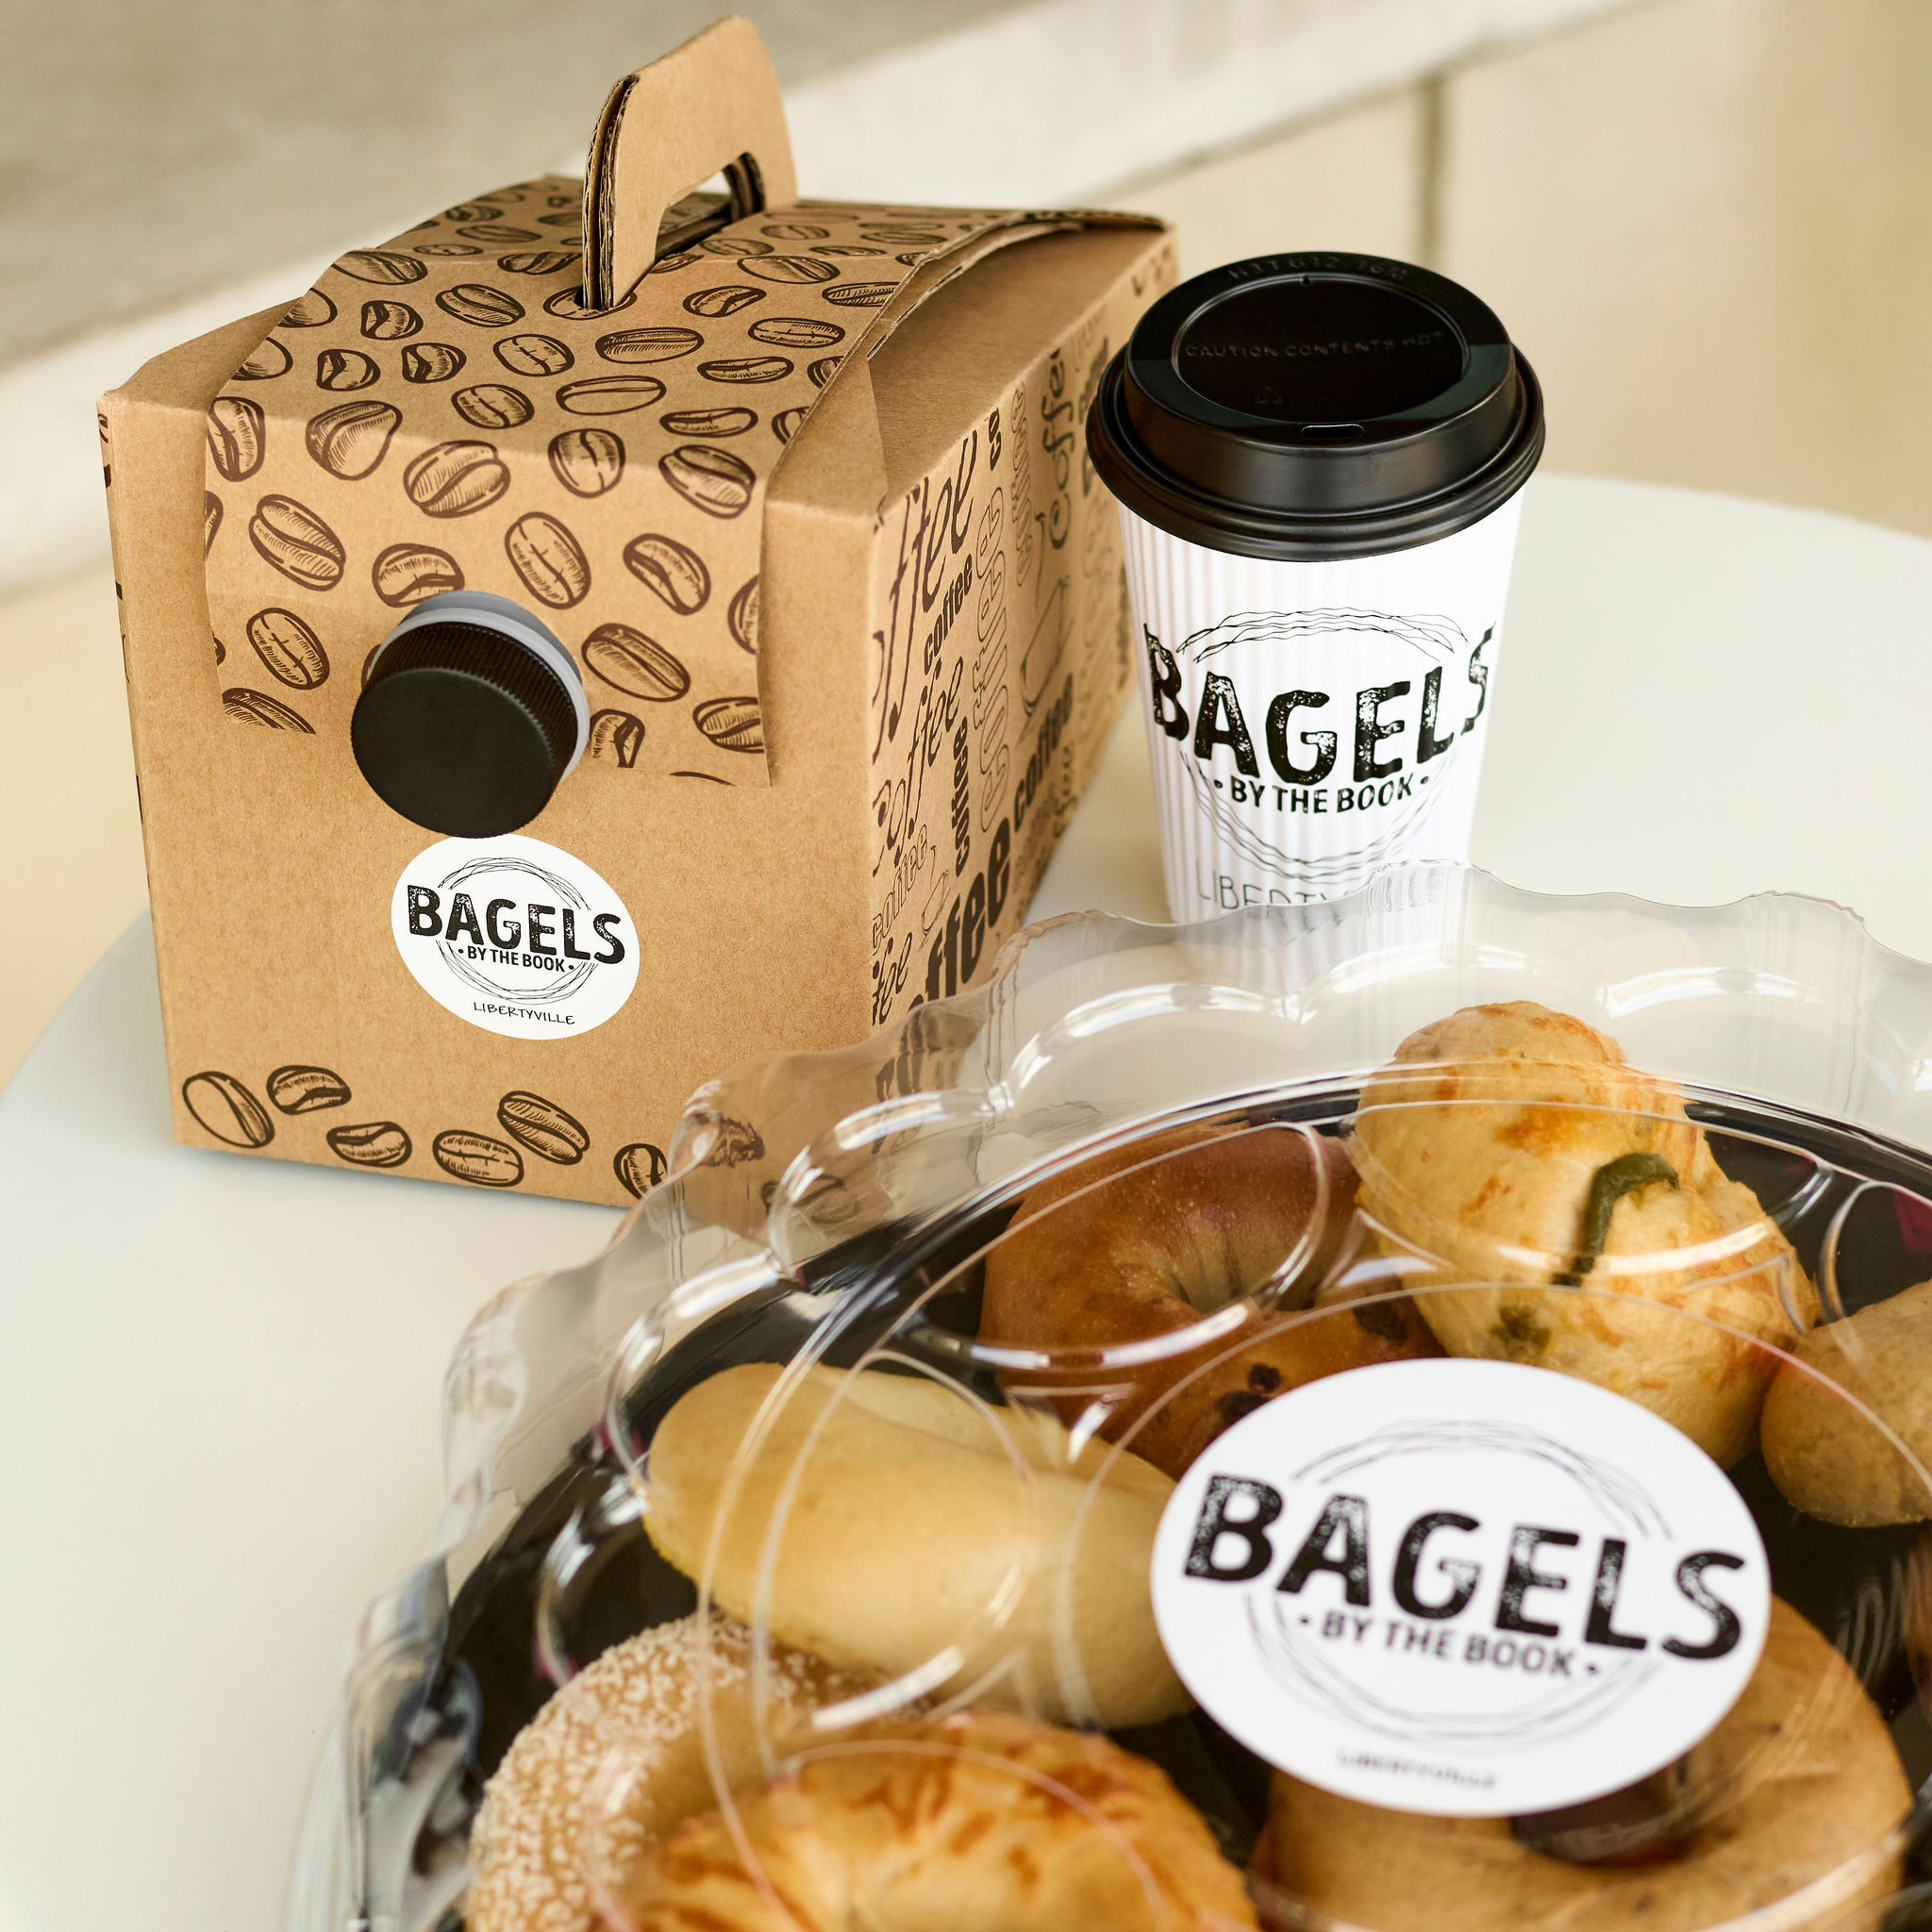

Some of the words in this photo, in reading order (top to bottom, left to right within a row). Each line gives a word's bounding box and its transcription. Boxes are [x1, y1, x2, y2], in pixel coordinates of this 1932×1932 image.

[924, 552, 973, 676] coffee
[972, 486, 1010, 833] coffee
[1143, 621, 1496, 787] BAGELS
[951, 716, 970, 877] coffee
[1230, 774, 1266, 808] BY
[1272, 785, 1328, 814] THE
[1336, 772, 1413, 813] BOOK
[407, 884, 625, 965] BAGELS
[467, 945, 487, 961] BY
[490, 949, 519, 966] THE
[522, 954, 565, 973] BOOK
[474, 1002, 575, 1025] LIBERTYVILLE
[1183, 1473, 1747, 1661] BAGELS
[1322, 1610, 1372, 1642] BY
[1384, 1620, 1455, 1658] THE
[1464, 1632, 1576, 1677] BOOK
